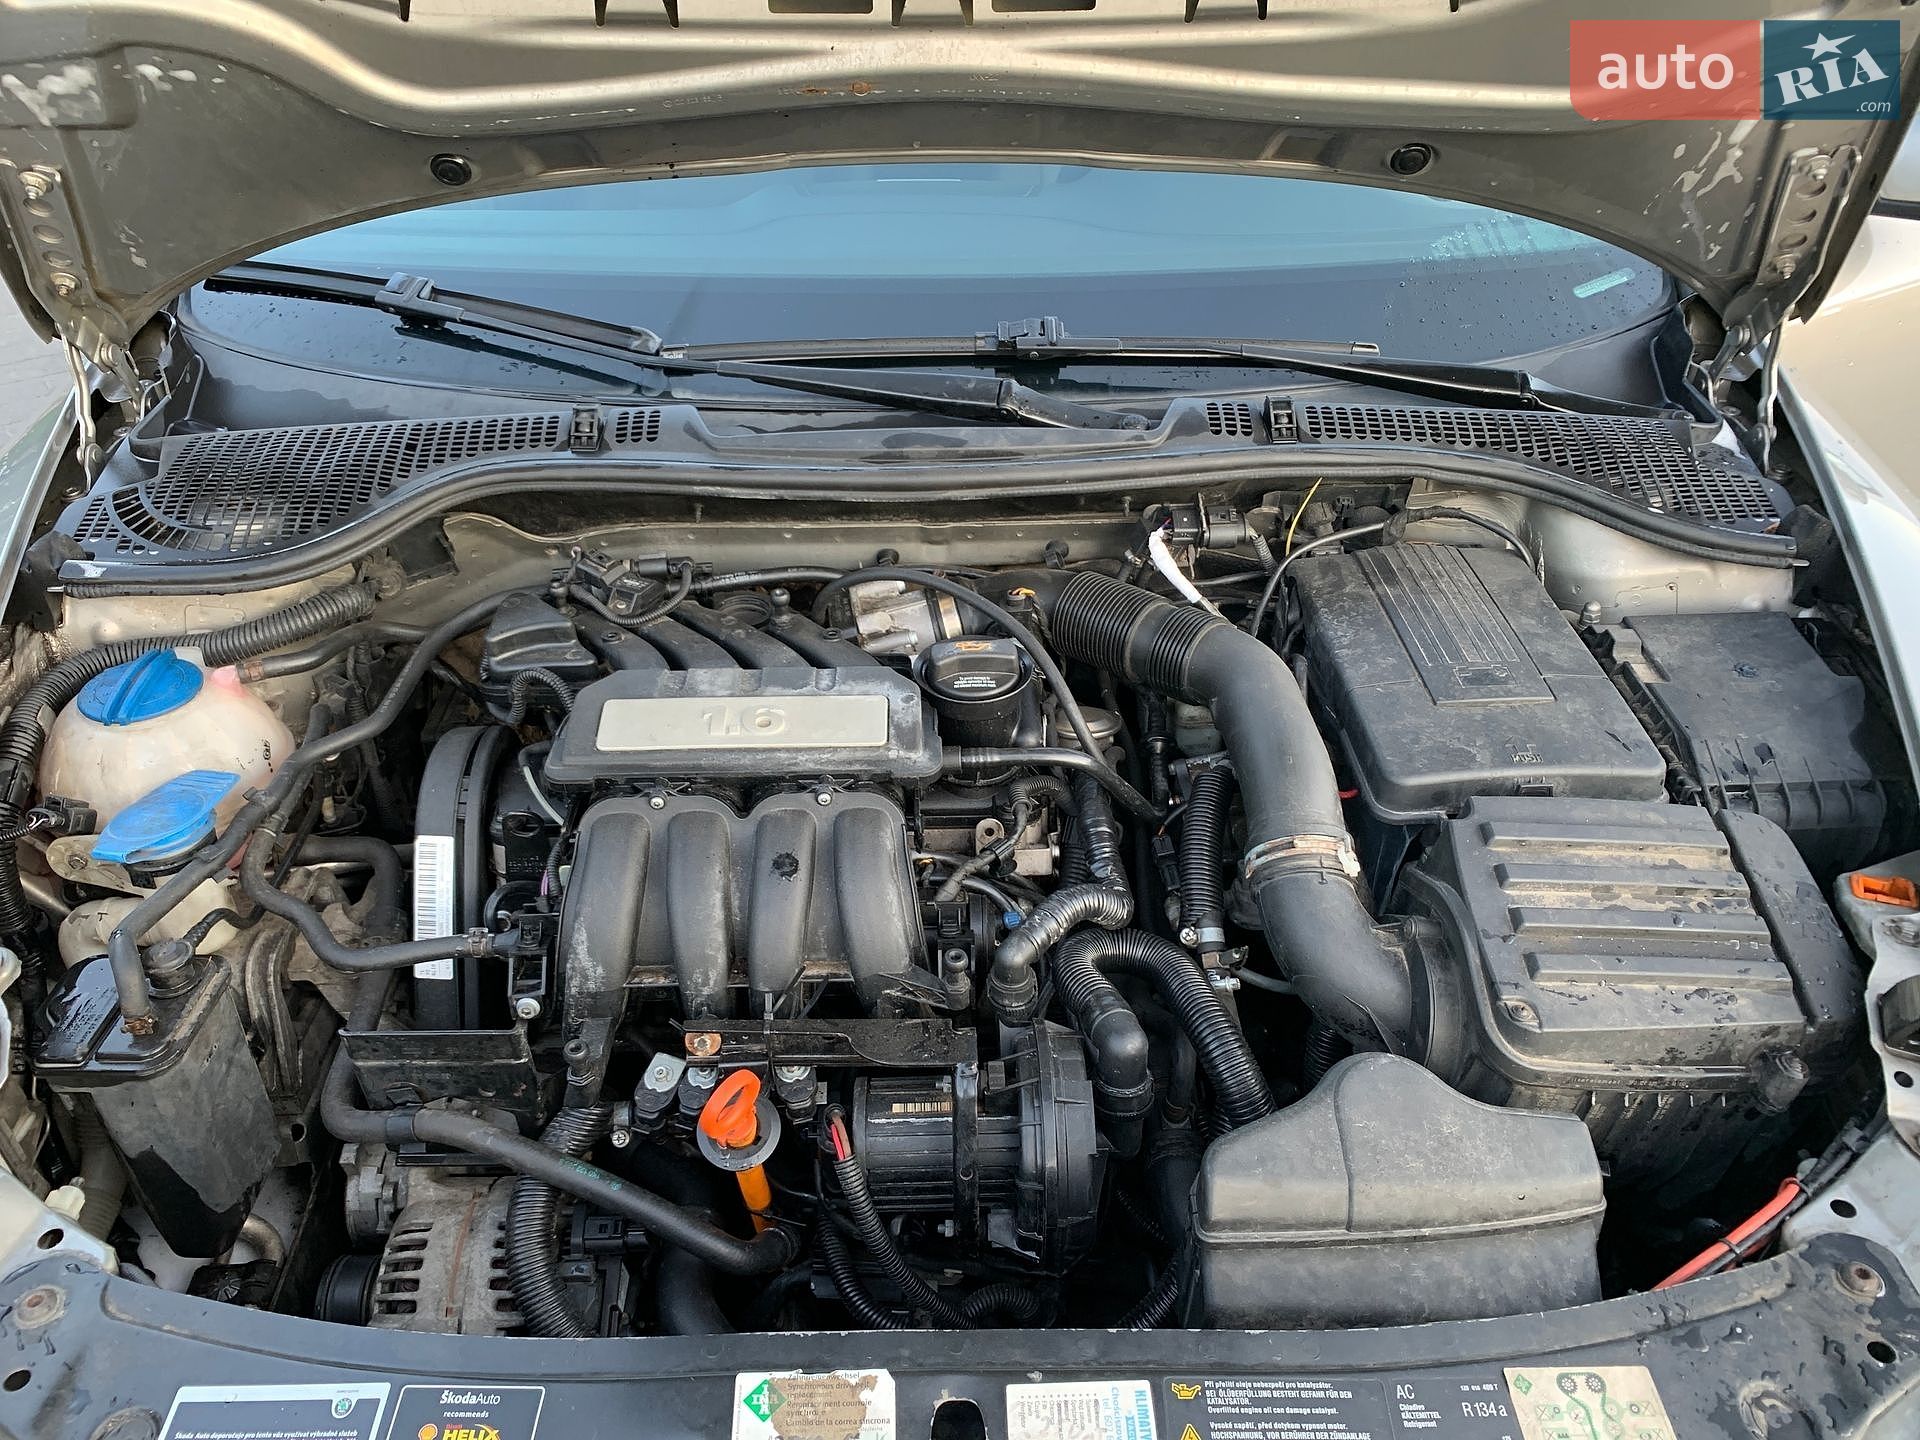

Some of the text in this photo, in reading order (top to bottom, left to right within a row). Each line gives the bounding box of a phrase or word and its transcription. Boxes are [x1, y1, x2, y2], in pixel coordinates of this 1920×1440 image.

[702, 704, 786, 736] 1.6
[1396, 1384, 1415, 1400] AC
[443, 1410, 489, 1418] recommends
